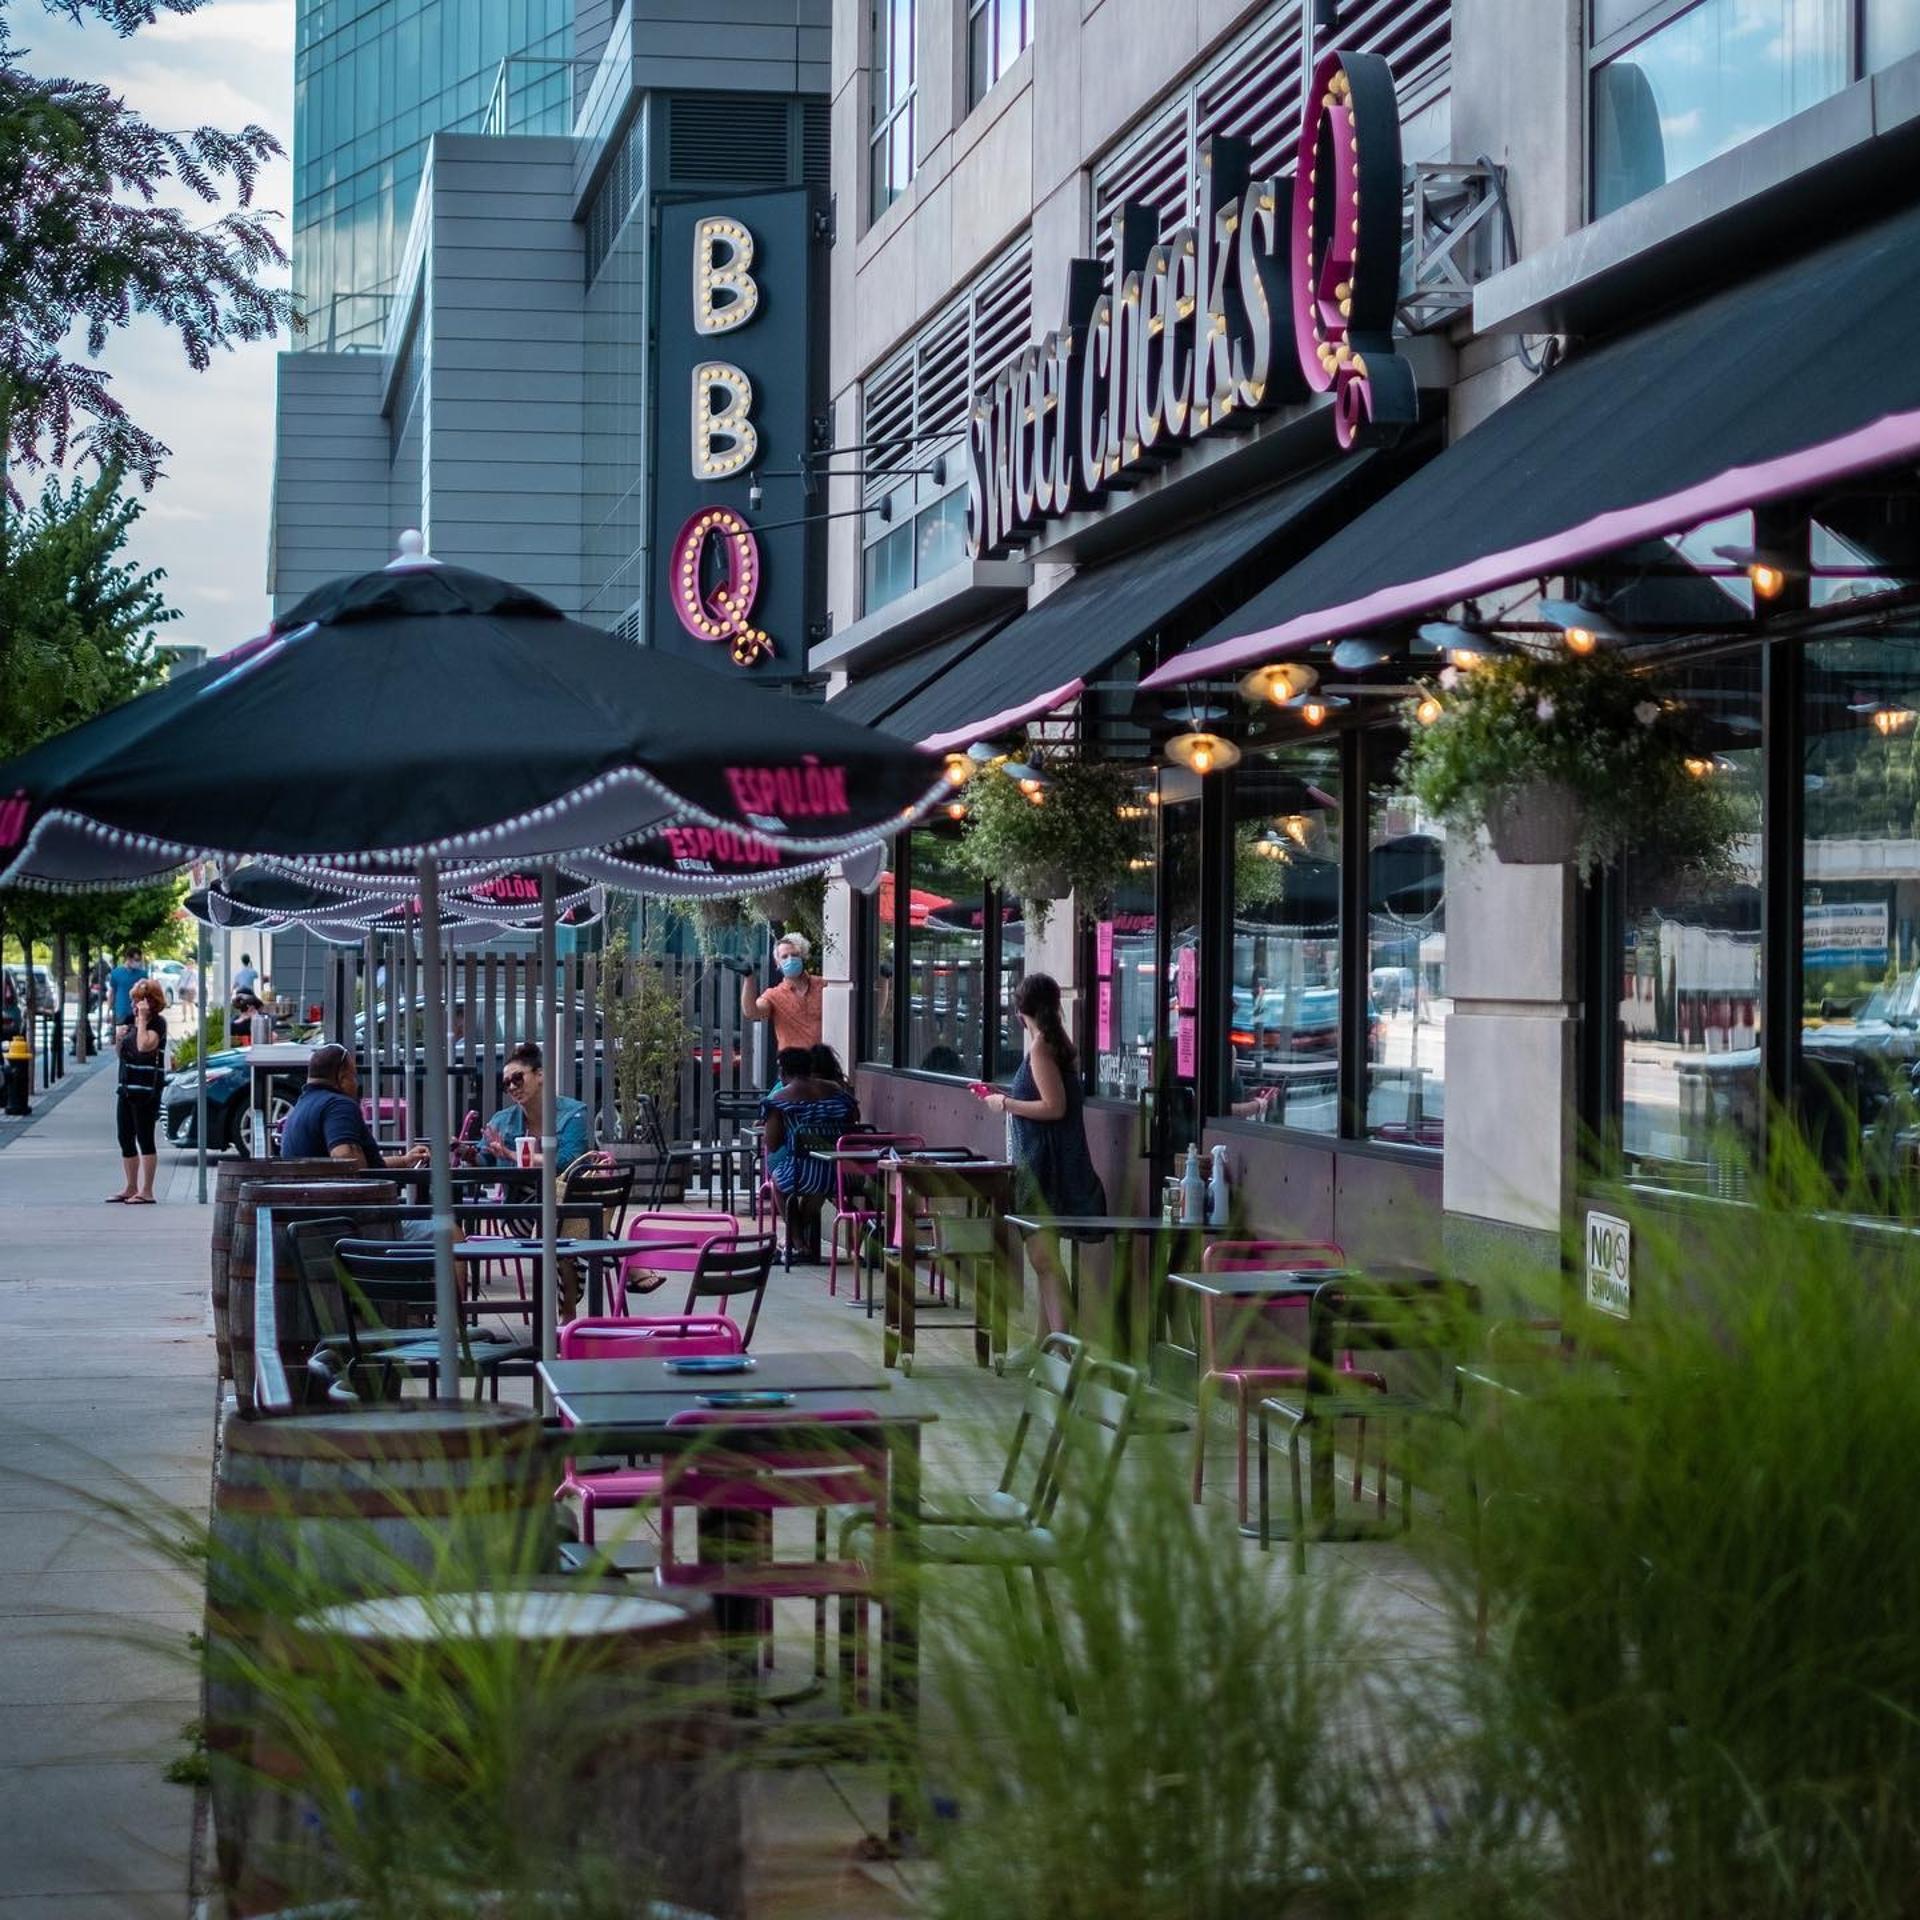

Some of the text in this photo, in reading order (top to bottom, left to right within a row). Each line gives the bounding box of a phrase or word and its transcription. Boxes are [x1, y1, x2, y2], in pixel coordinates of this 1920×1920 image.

[670, 215, 775, 667] BBQ
[1082, 135, 1280, 491] cheeks
[1292, 50, 1400, 448] Q
[1591, 1225, 1611, 1269] NO
